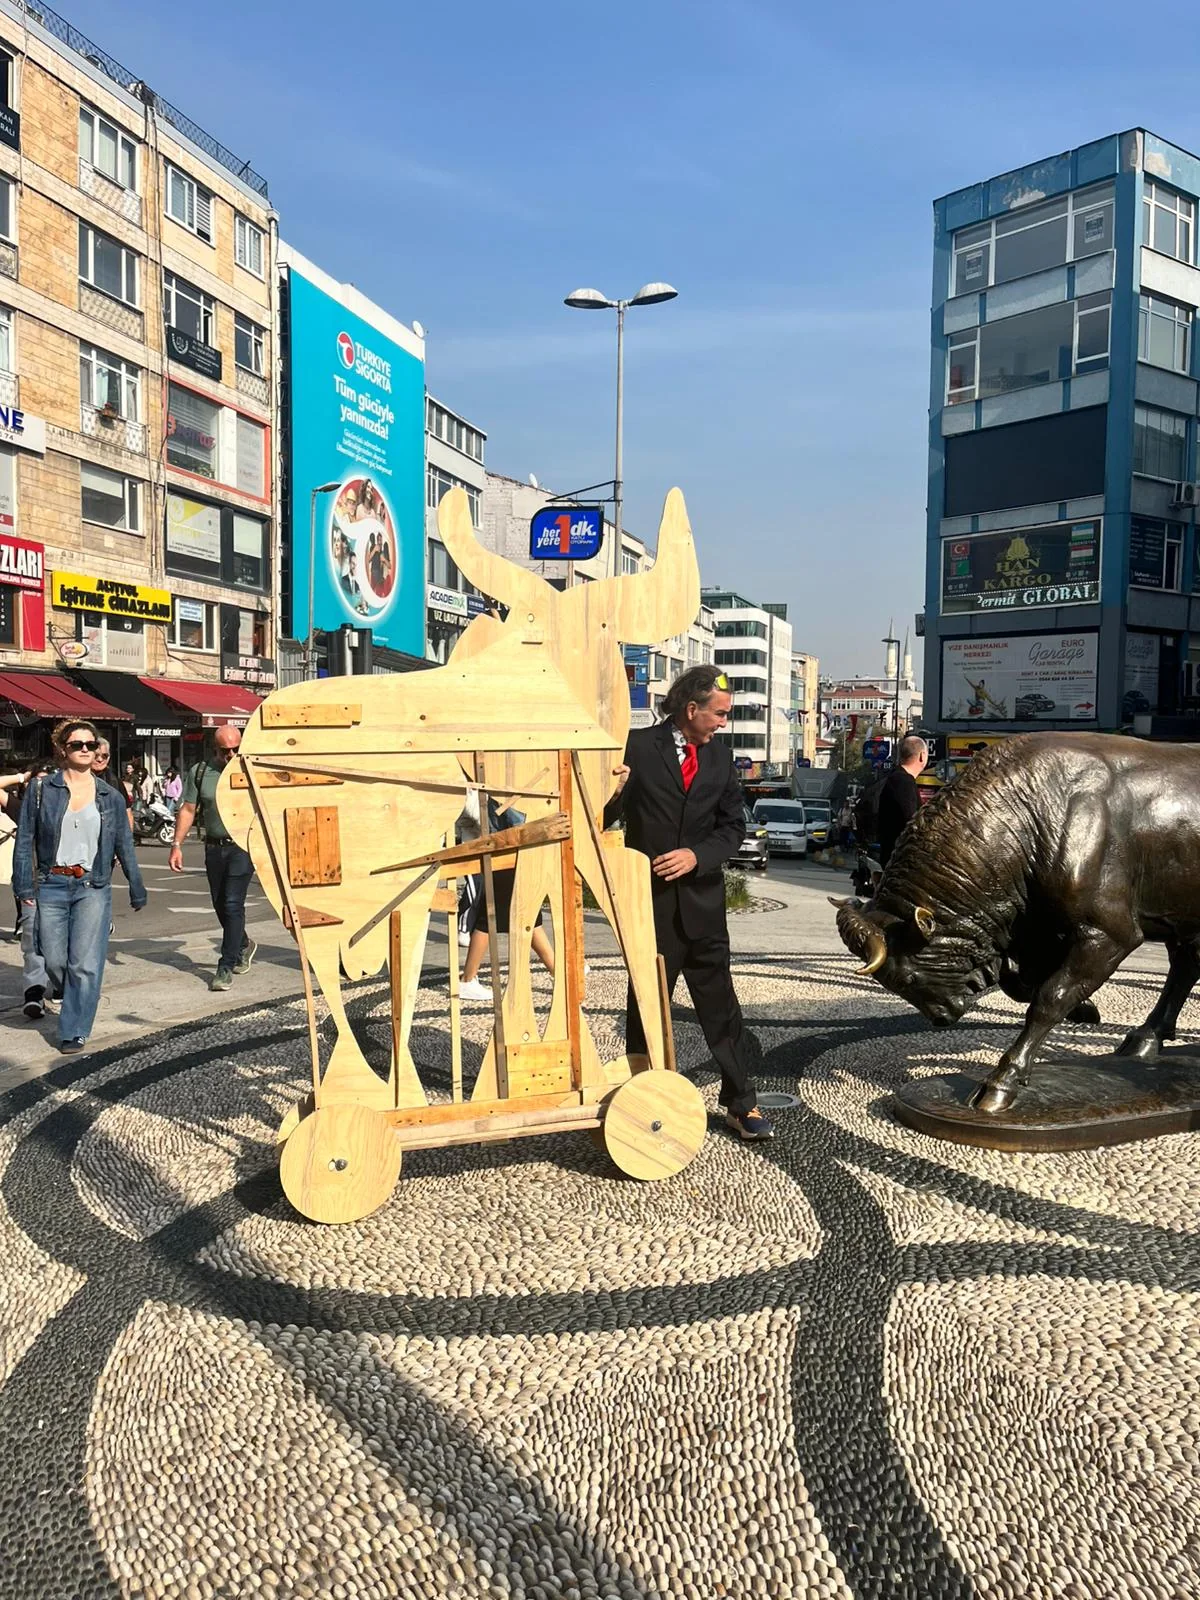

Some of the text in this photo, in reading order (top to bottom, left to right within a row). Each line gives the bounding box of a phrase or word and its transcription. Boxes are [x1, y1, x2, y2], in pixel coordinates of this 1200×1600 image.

[333, 374, 394, 424] Tüm gücüyle
[340, 404, 388, 440] yanınızda!
[543, 527, 560, 538] her
[554, 514, 597, 554] 1 dk.
[536, 537, 560, 549] yere
[996, 557, 1040, 573] HAN
[984, 573, 1051, 590] KARGO
[60, 584, 105, 608] İŞİTME
[108, 593, 170, 619] CİHAZLARI
[1061, 639, 1085, 648] EURO
[1028, 642, 1085, 666] Garage
